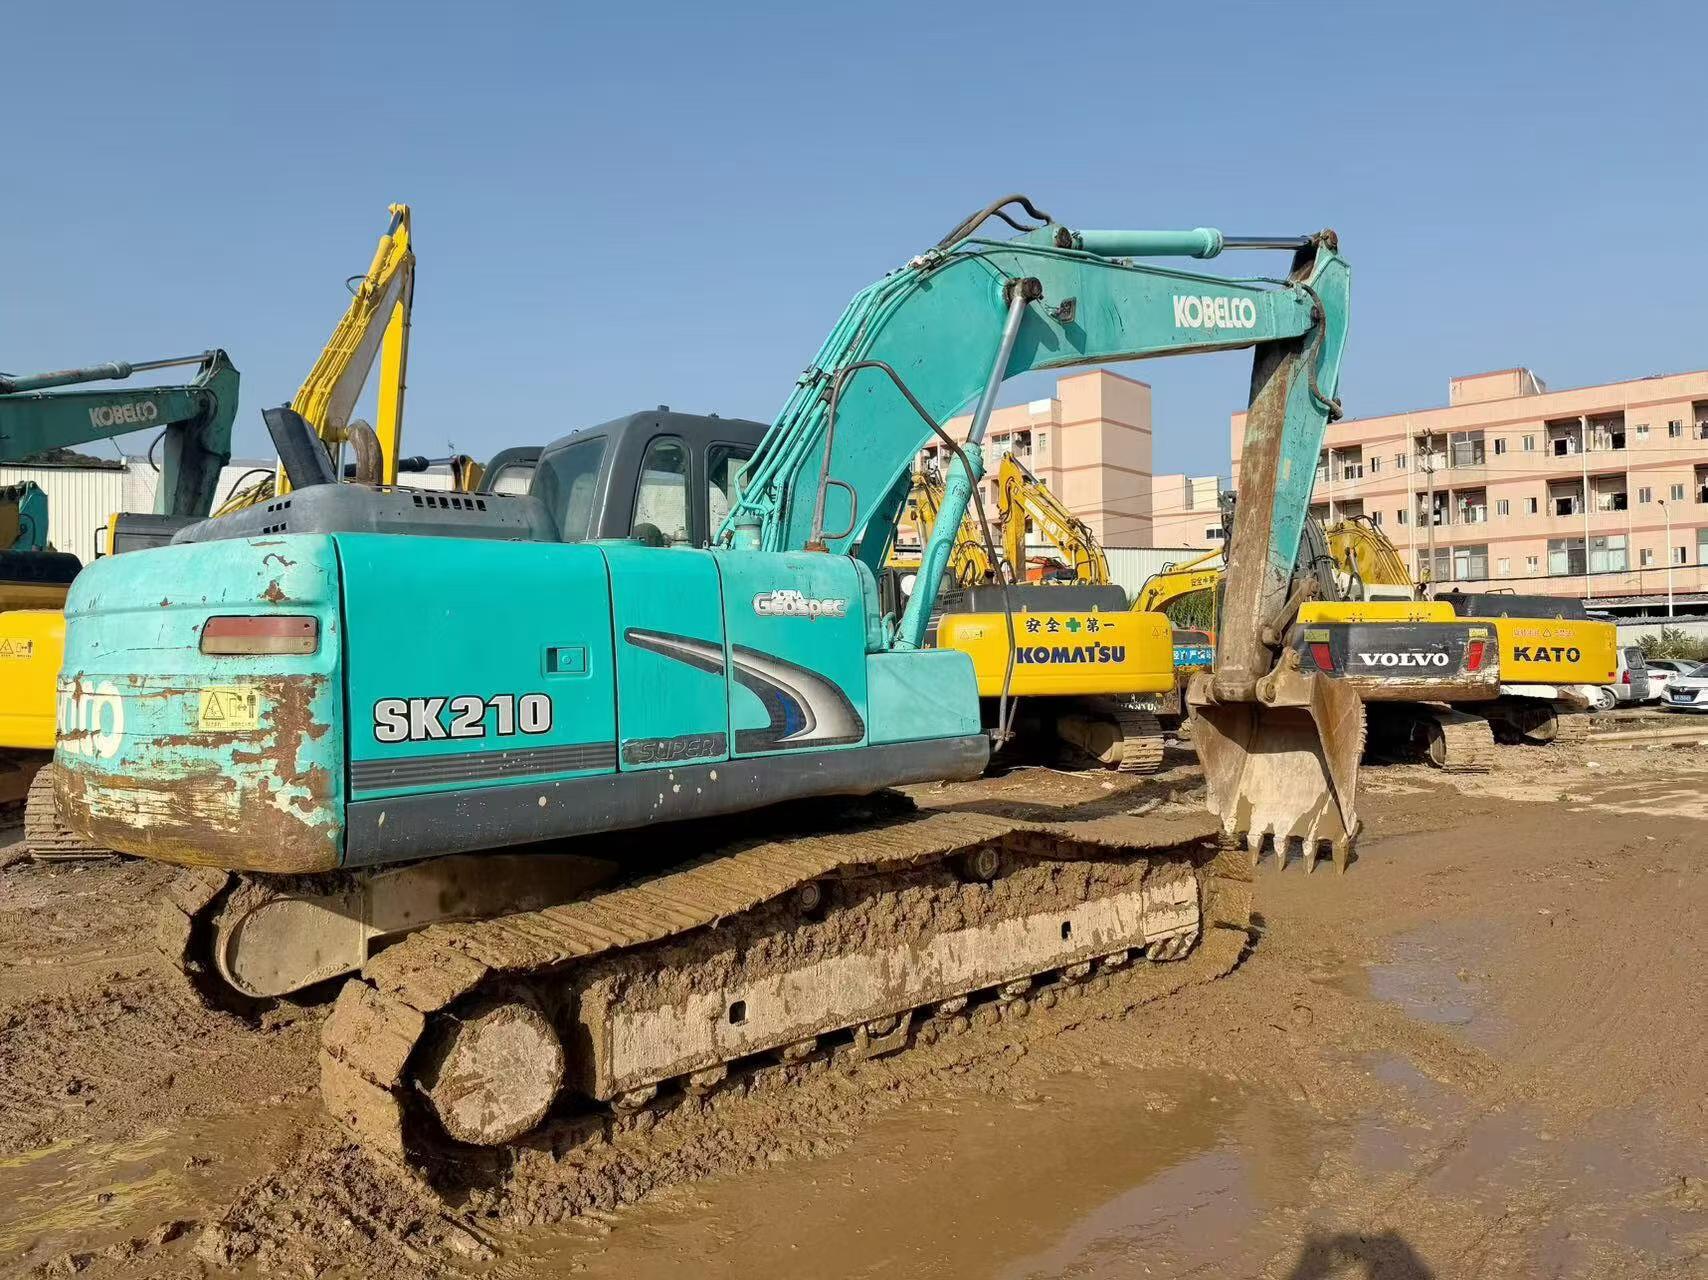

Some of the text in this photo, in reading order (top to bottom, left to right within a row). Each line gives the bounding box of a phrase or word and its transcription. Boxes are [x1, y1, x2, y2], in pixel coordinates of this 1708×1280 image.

[1172, 294, 1257, 328] KOBELCO
[88, 400, 158, 428] KOBELCO
[1016, 641, 1126, 664] KOMATSU
[1358, 652, 1450, 667] VOLVO
[1513, 646, 1581, 663] KATO
[373, 693, 553, 744] SK210
[639, 738, 716, 762] SUPER
